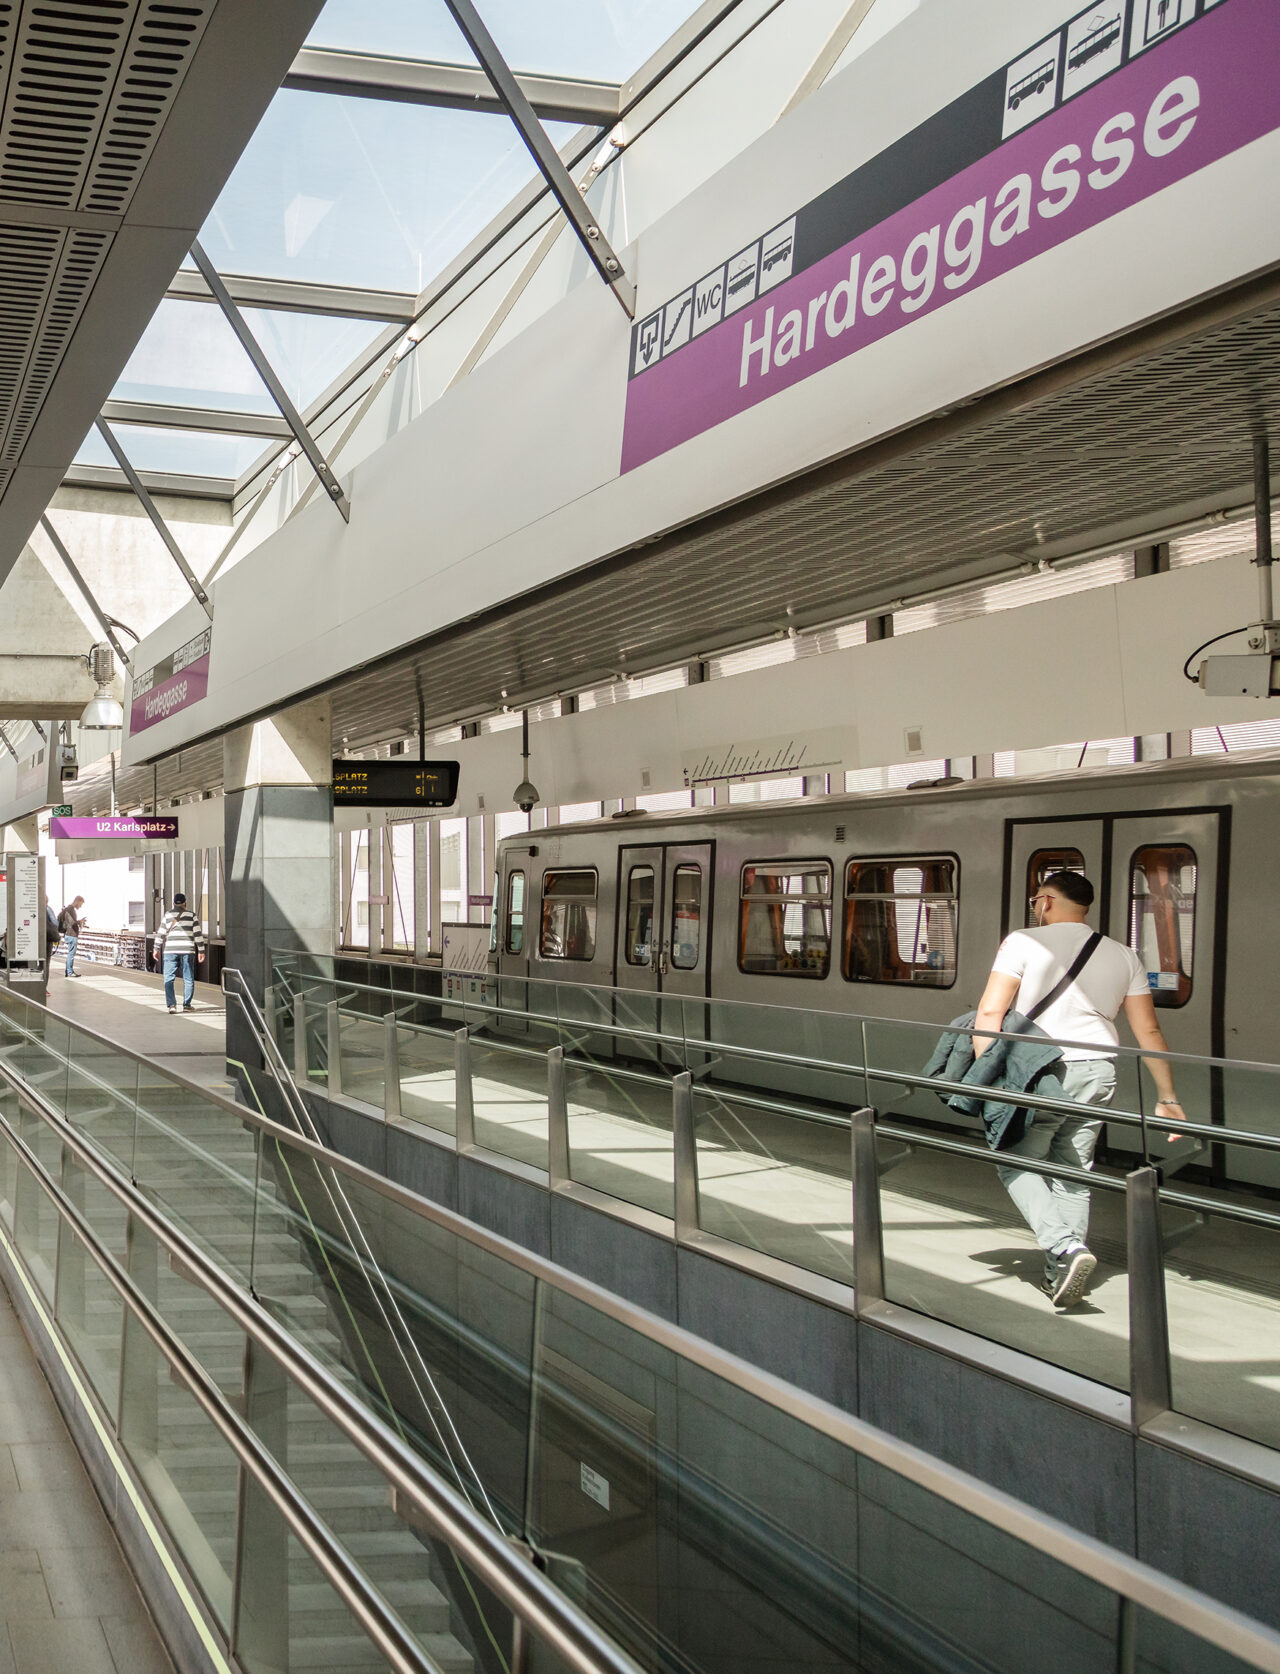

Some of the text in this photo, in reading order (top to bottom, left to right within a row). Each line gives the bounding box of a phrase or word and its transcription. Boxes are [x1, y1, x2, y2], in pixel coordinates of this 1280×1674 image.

[739, 75, 1200, 388] Hardeggasse
[697, 284, 722, 318] WC
[145, 679, 188, 721] Hardeggasse
[53, 806, 72, 816] SOS
[96, 822, 167, 834] U2 Karlsplatz
